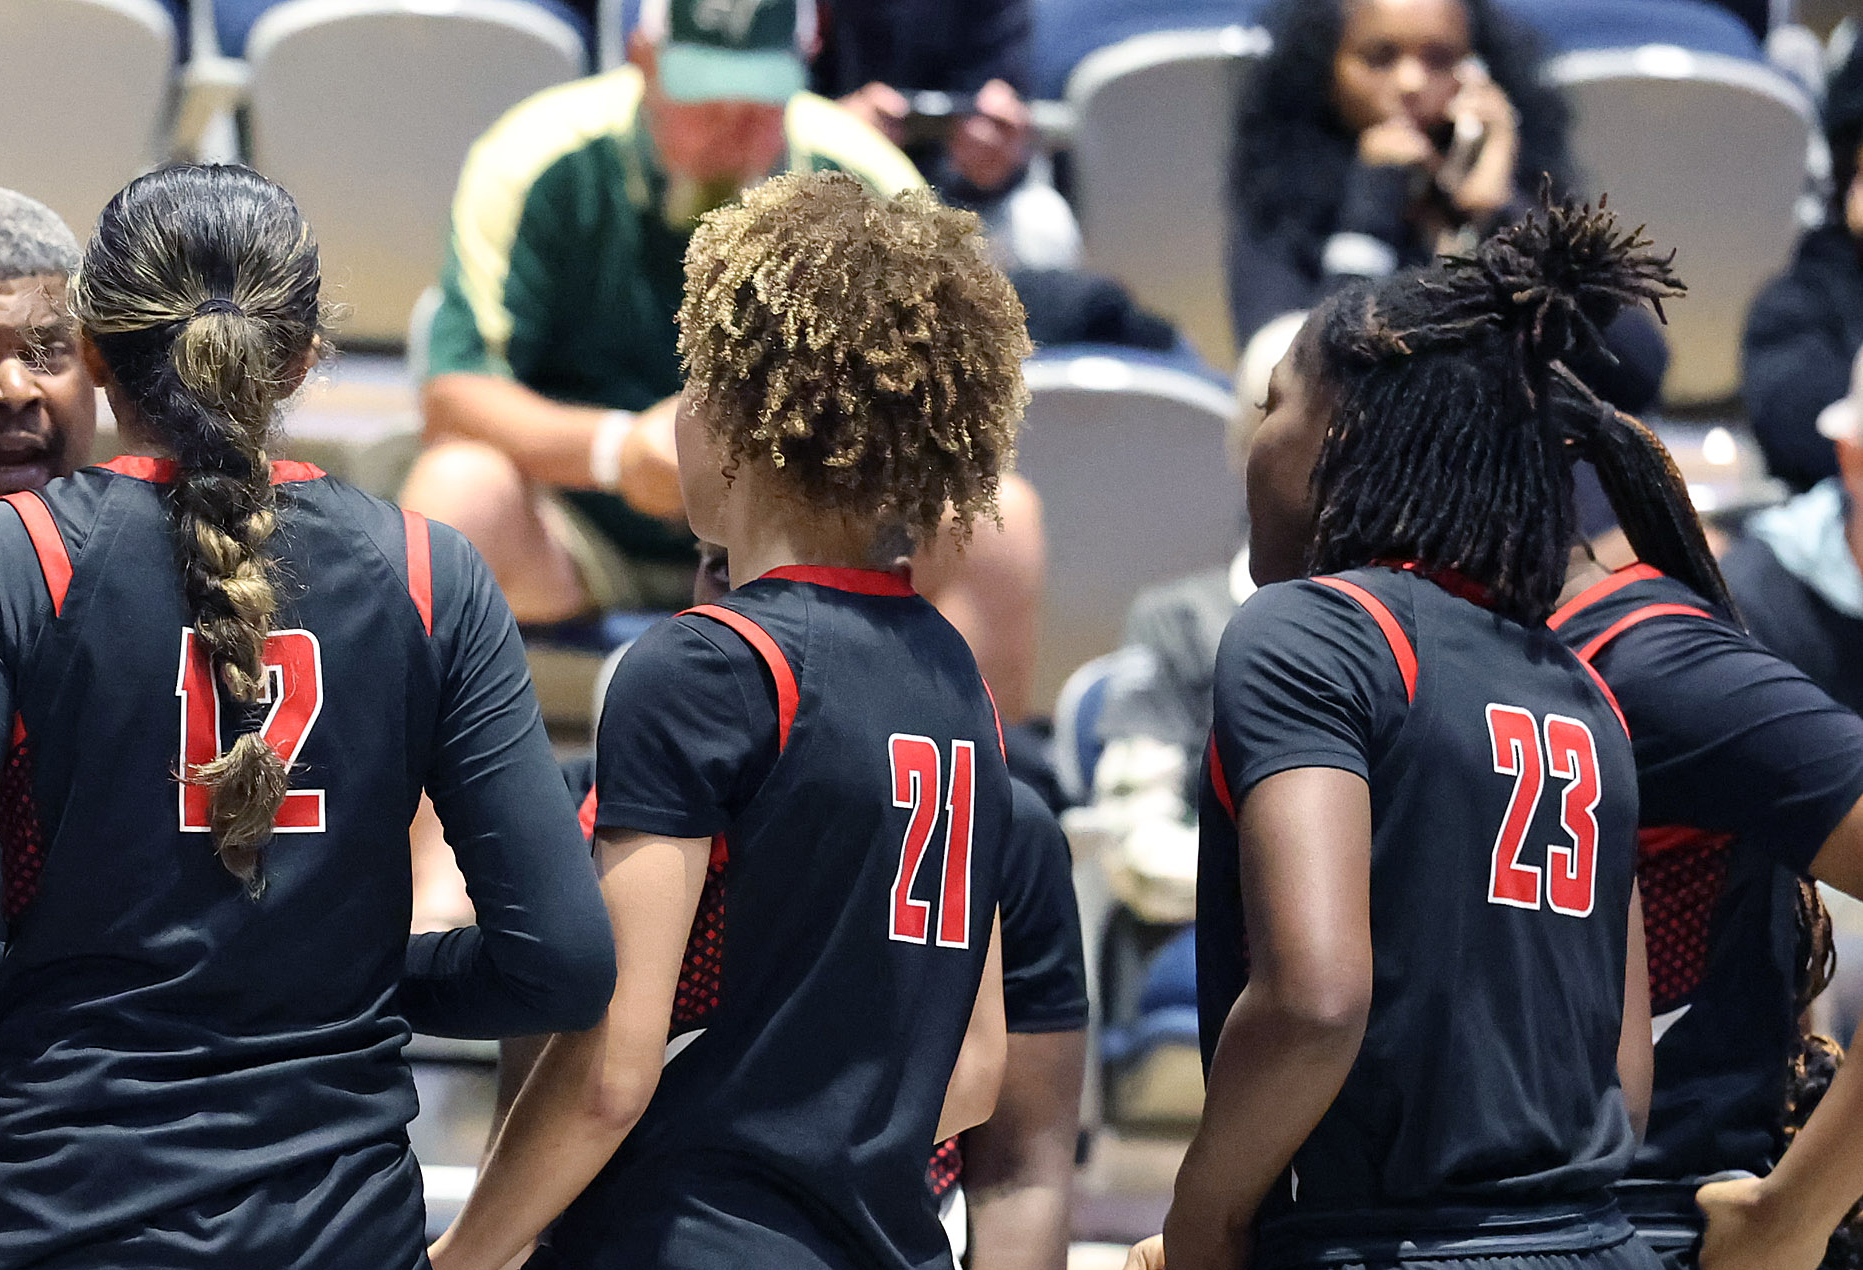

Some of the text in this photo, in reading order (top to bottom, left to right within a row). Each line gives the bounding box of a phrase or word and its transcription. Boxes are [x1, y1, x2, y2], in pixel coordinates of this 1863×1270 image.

[175, 626, 326, 833] 12
[1485, 702, 1602, 918] 23
[888, 732, 976, 950] 21
